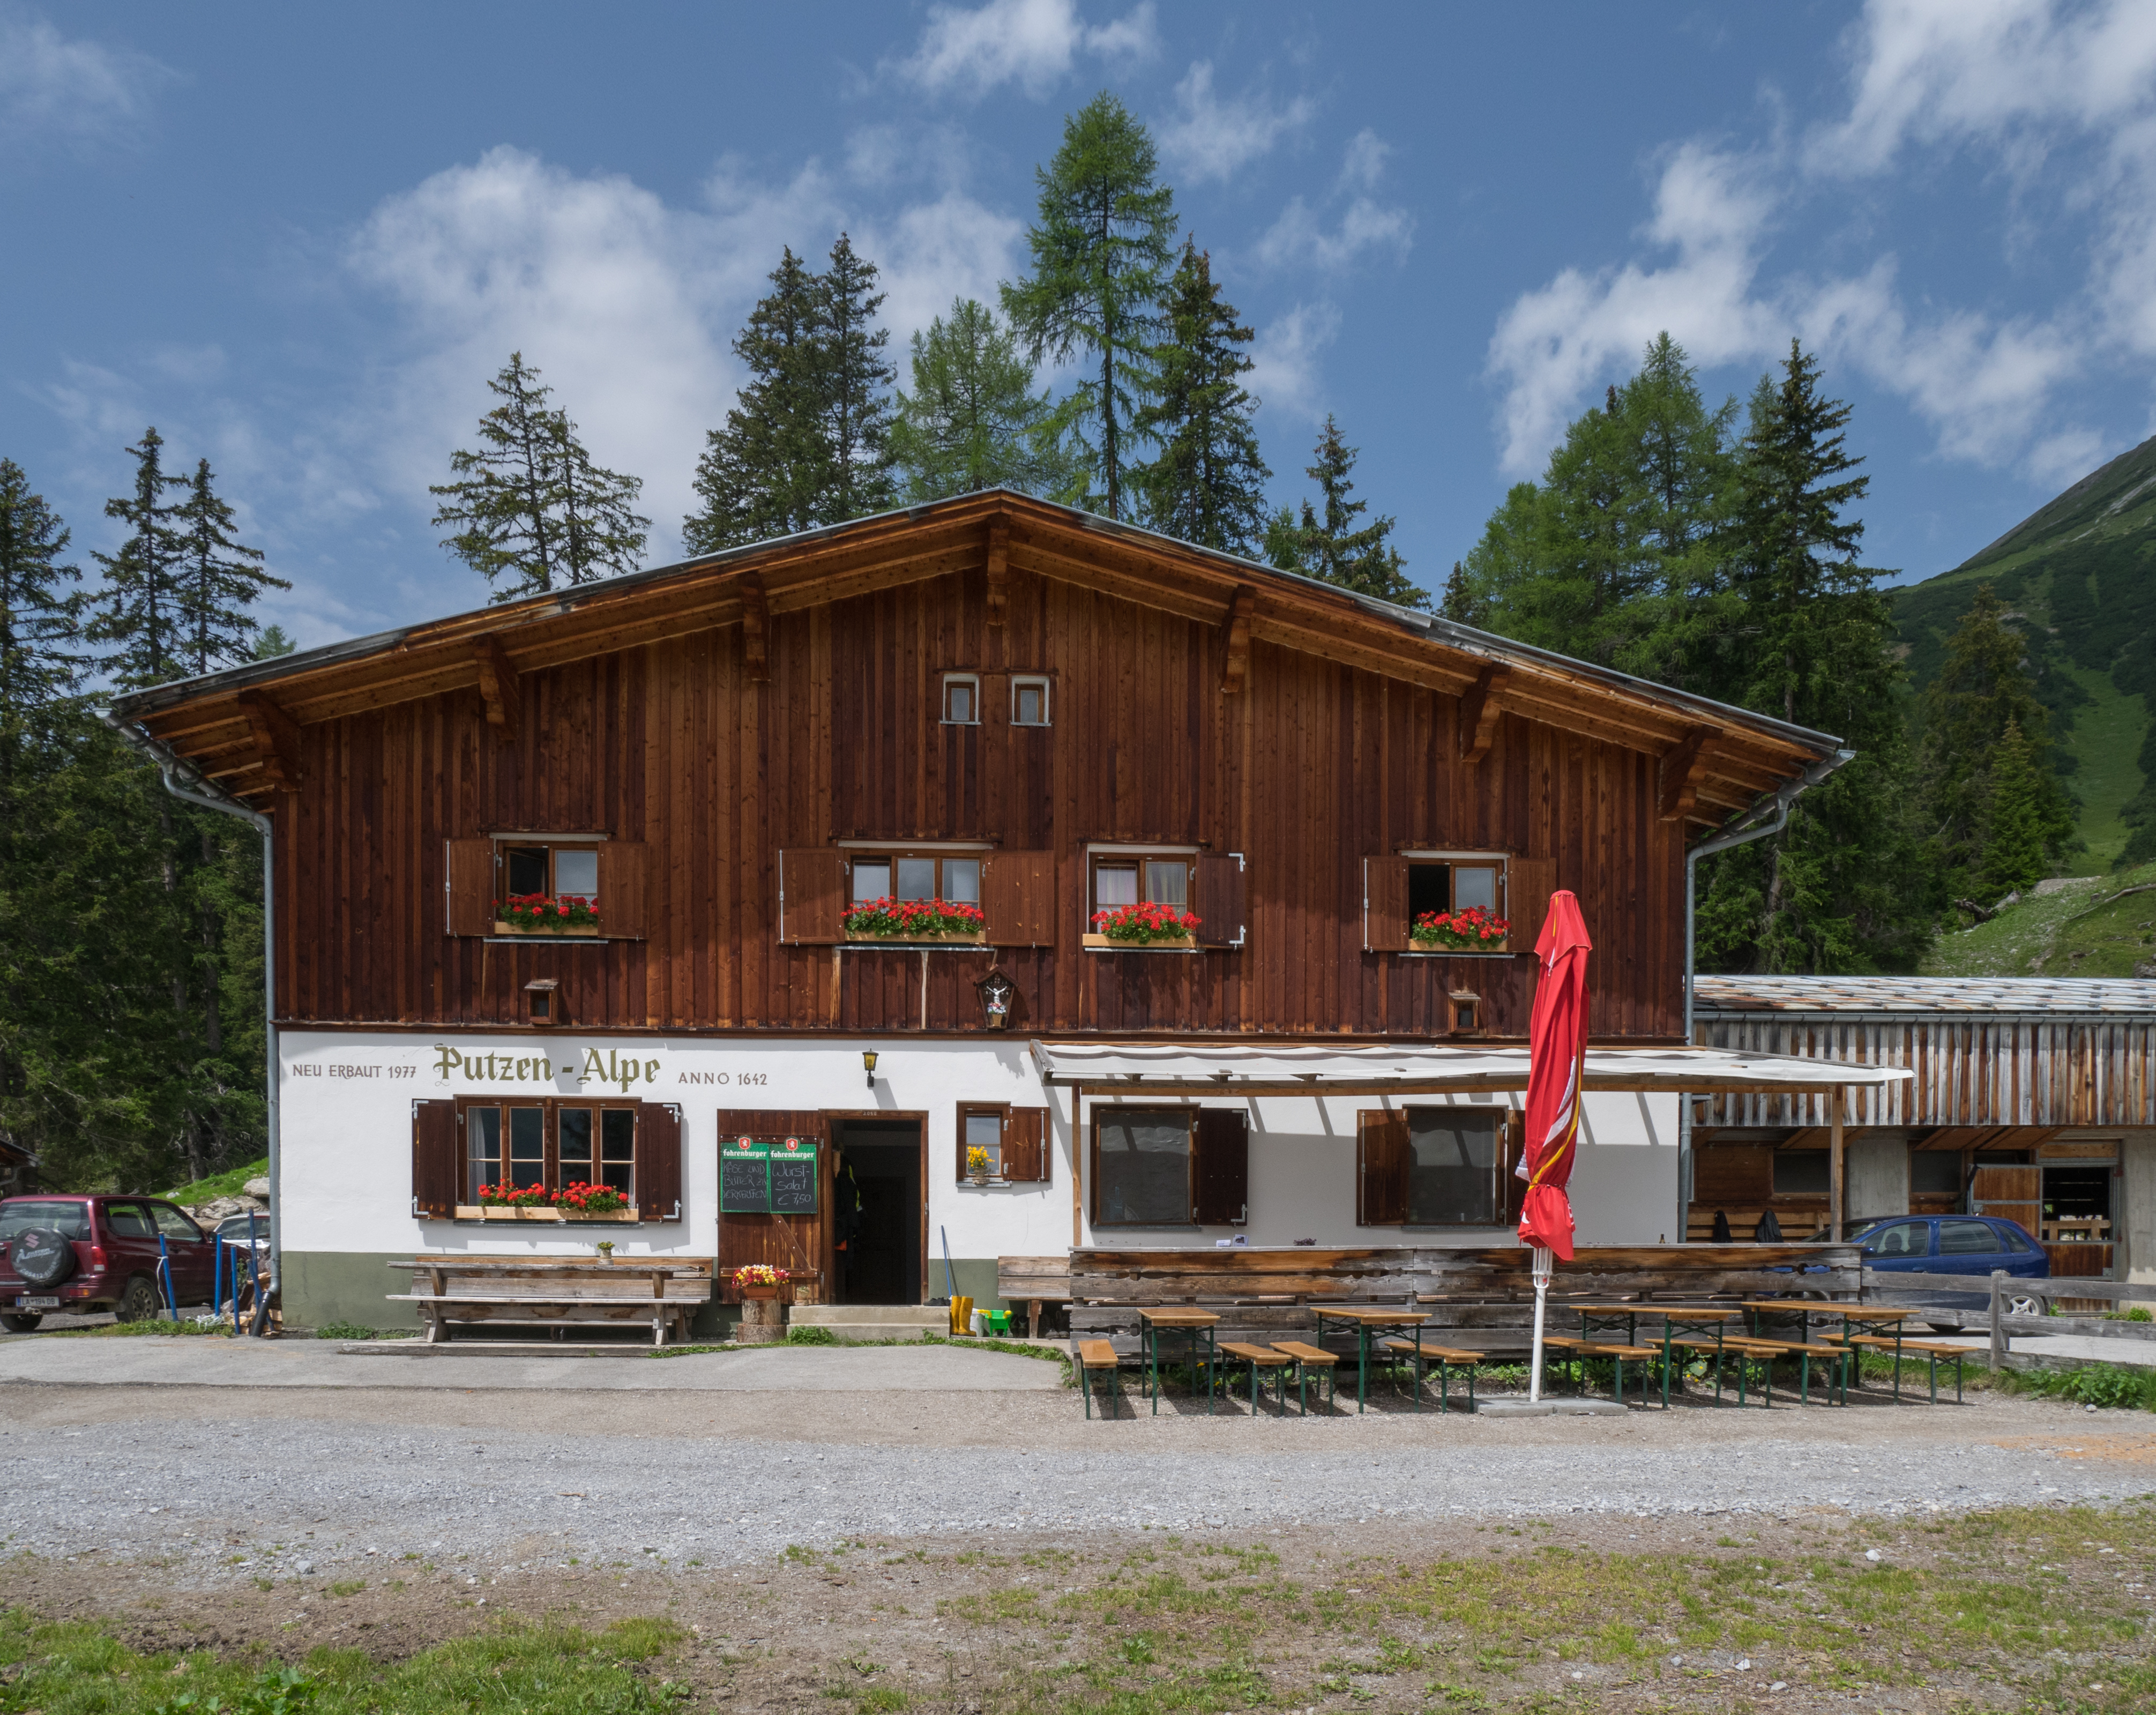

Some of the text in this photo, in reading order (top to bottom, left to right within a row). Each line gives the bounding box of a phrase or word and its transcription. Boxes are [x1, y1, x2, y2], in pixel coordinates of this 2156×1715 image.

[293, 1064, 416, 1079] NEU ERBAUT 1977
[678, 1072, 767, 1086] ANNO 1642
[723, 1149, 767, 1158] fohrenburger
[770, 1150, 814, 1159] fohrenburger
[748, 1164, 765, 1175] UND
[723, 1174, 755, 1187] BUTTER
